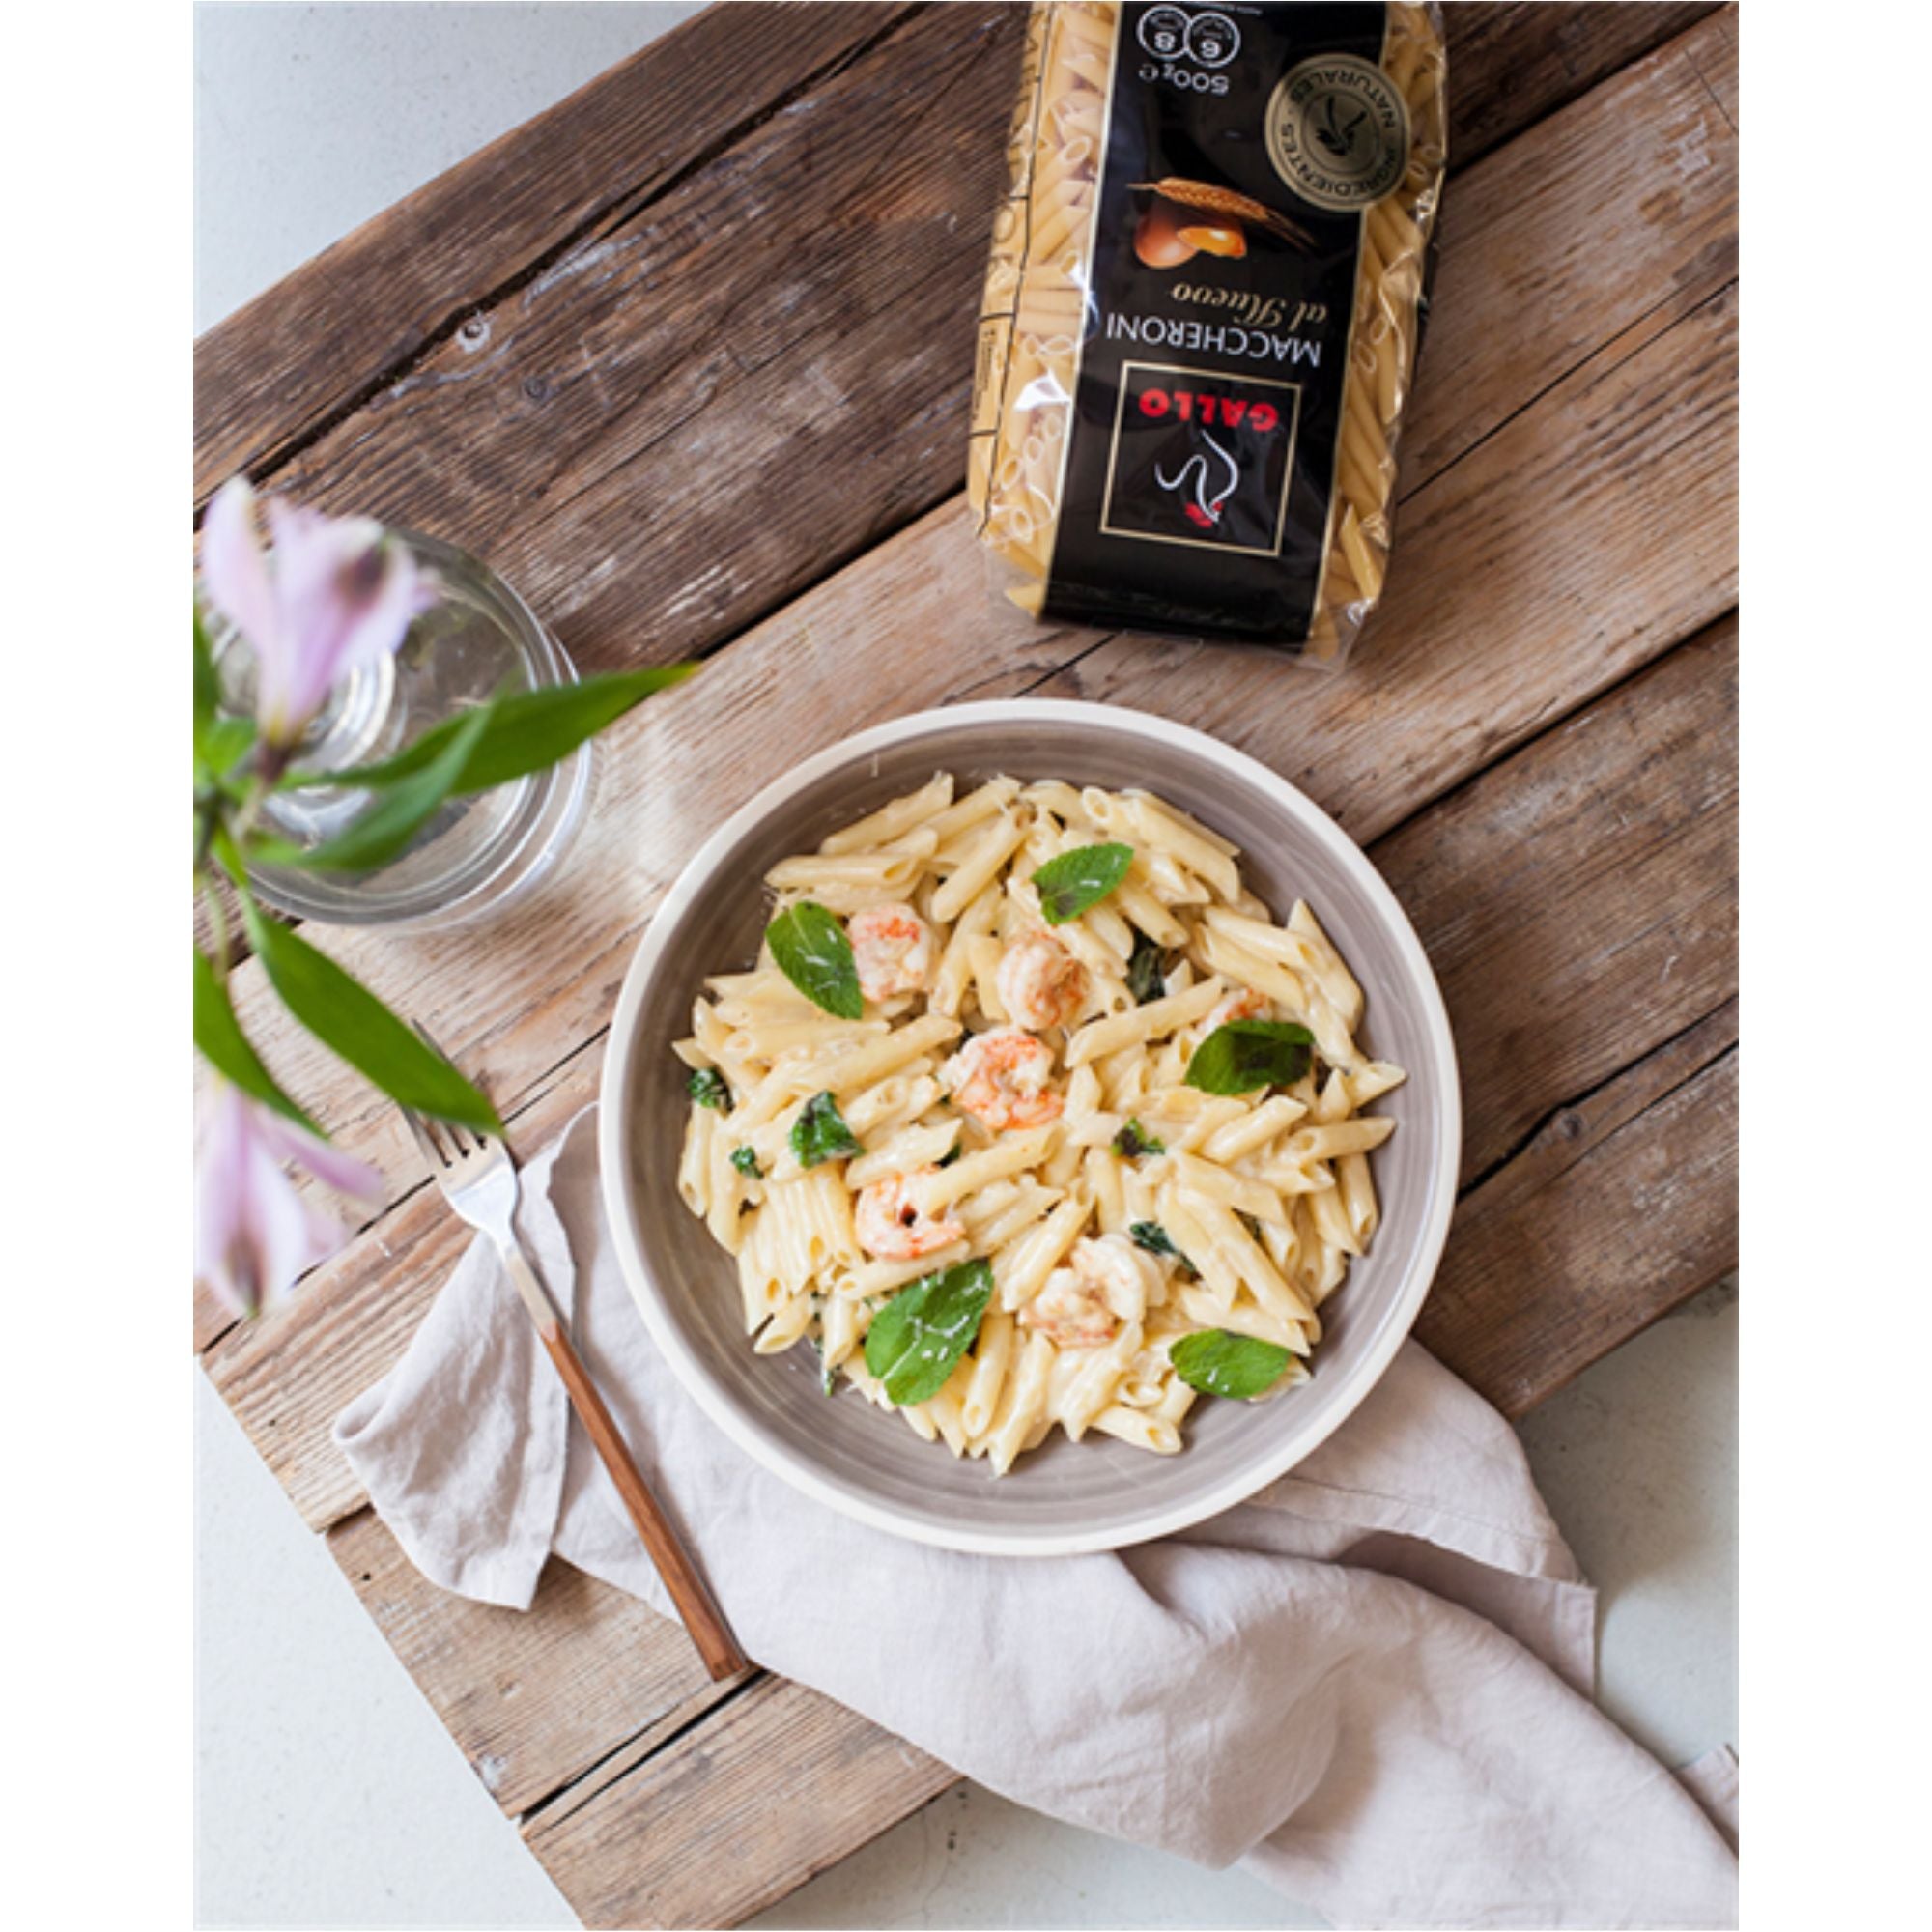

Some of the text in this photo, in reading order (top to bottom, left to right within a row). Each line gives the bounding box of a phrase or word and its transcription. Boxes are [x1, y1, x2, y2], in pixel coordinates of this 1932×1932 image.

[1154, 31, 1176, 52] 8
[1200, 40, 1221, 59] 6
[1162, 64, 1229, 95] 500g
[1289, 69, 1397, 128] NATURALES
[1169, 280, 1328, 333] al Huevo
[1106, 312, 1321, 368] MACCHERONI
[1138, 388, 1280, 432] GALLO
